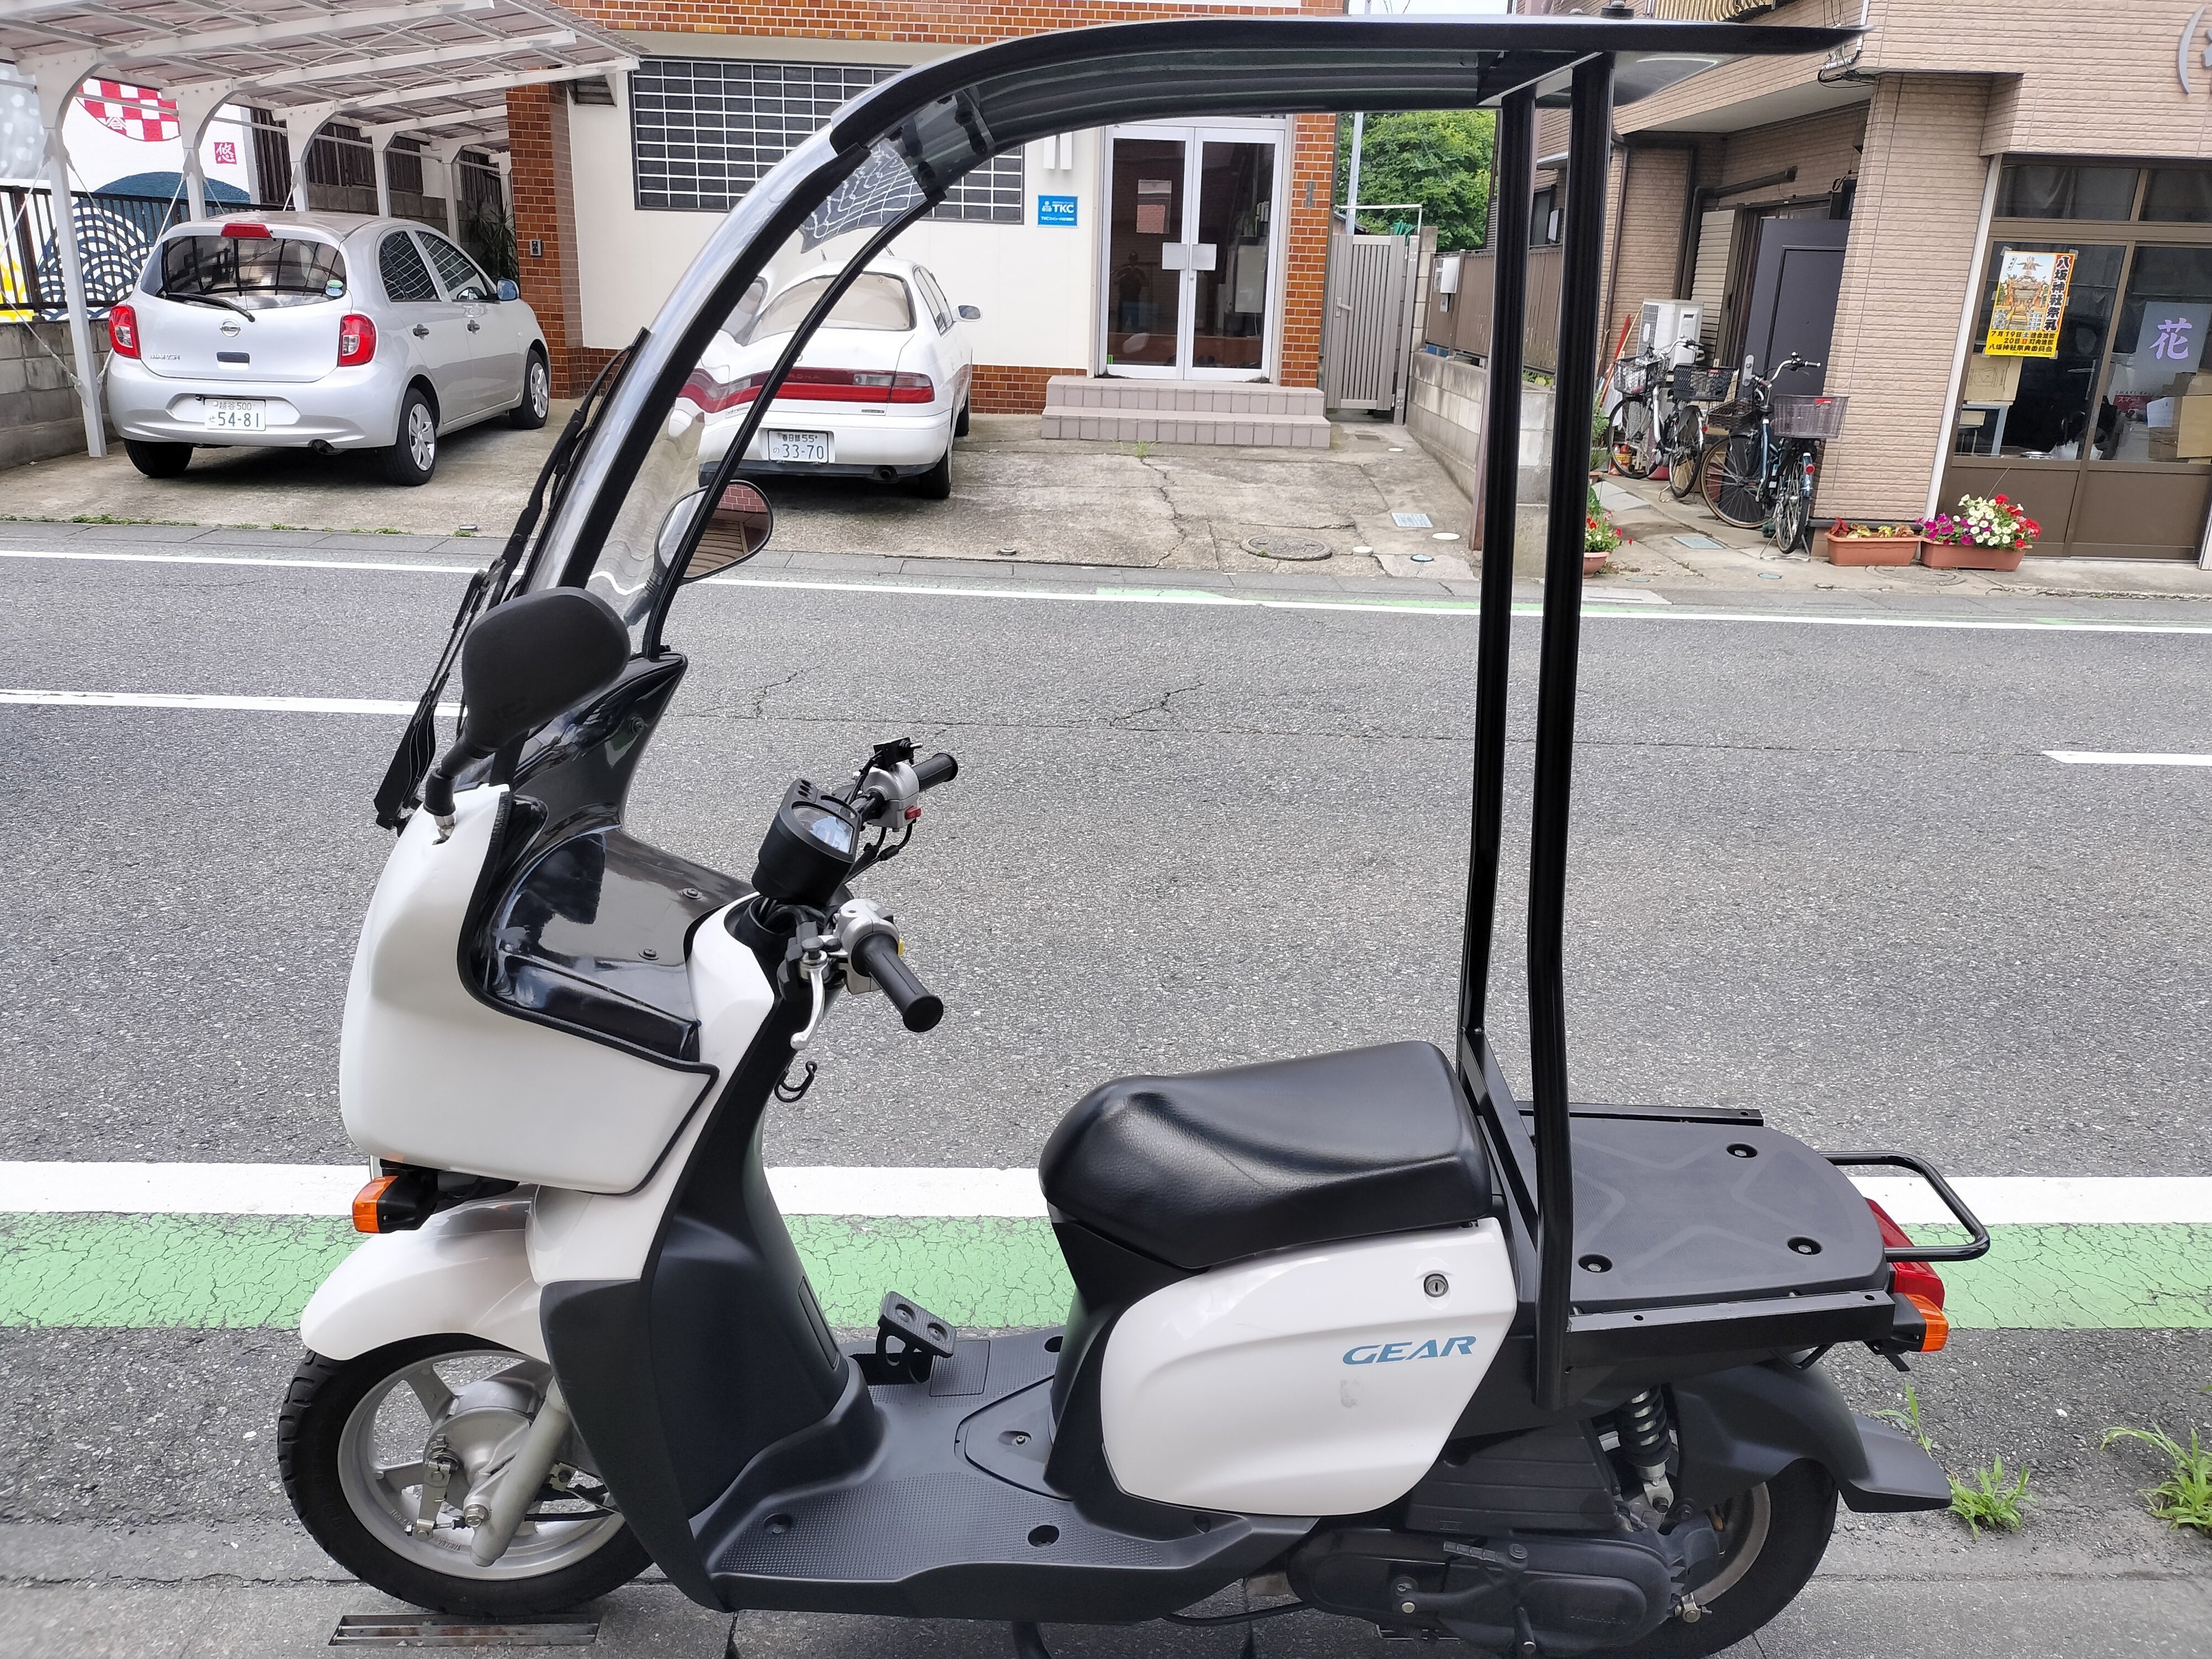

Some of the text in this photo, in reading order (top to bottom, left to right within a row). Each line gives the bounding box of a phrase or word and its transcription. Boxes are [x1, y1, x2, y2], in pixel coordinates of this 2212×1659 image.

[216, 143, 235, 162] 悠
[1052, 204, 1074, 213] TKC
[2043, 257, 2069, 331] 八坂神社祭礼
[2150, 317, 2192, 359] 花
[237, 402, 252, 410] 500
[218, 411, 259, 427] 54-81
[802, 434, 815, 442] 55
[782, 444, 824, 459] 33-70
[1342, 1335, 1477, 1365] GEAR
